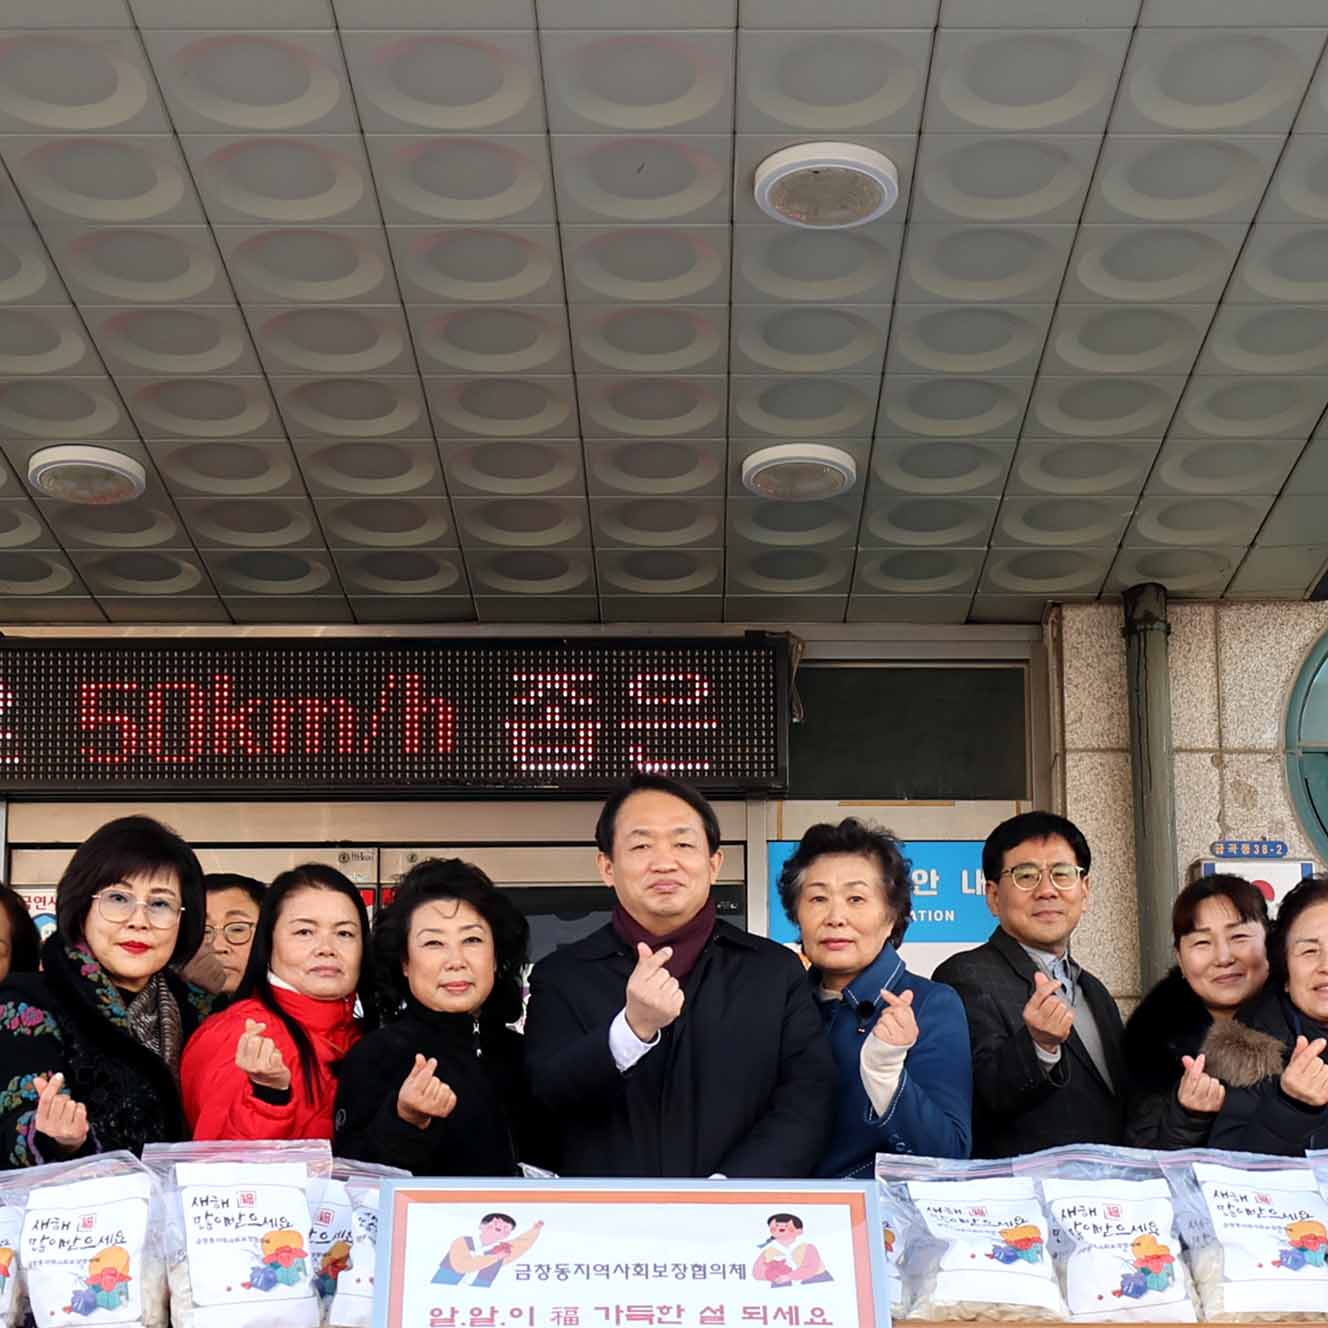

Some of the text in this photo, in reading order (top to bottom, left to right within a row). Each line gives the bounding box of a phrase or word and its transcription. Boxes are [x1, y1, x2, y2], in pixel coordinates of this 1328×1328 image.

[80, 674, 455, 764] 50km/h
[505, 674, 718, 770] 좁은
[514, 1262, 748, 1281] 금창동지역사회보장협의체
[428, 1304, 834, 1328] 알.알.이 福 가득한 설 되세요
